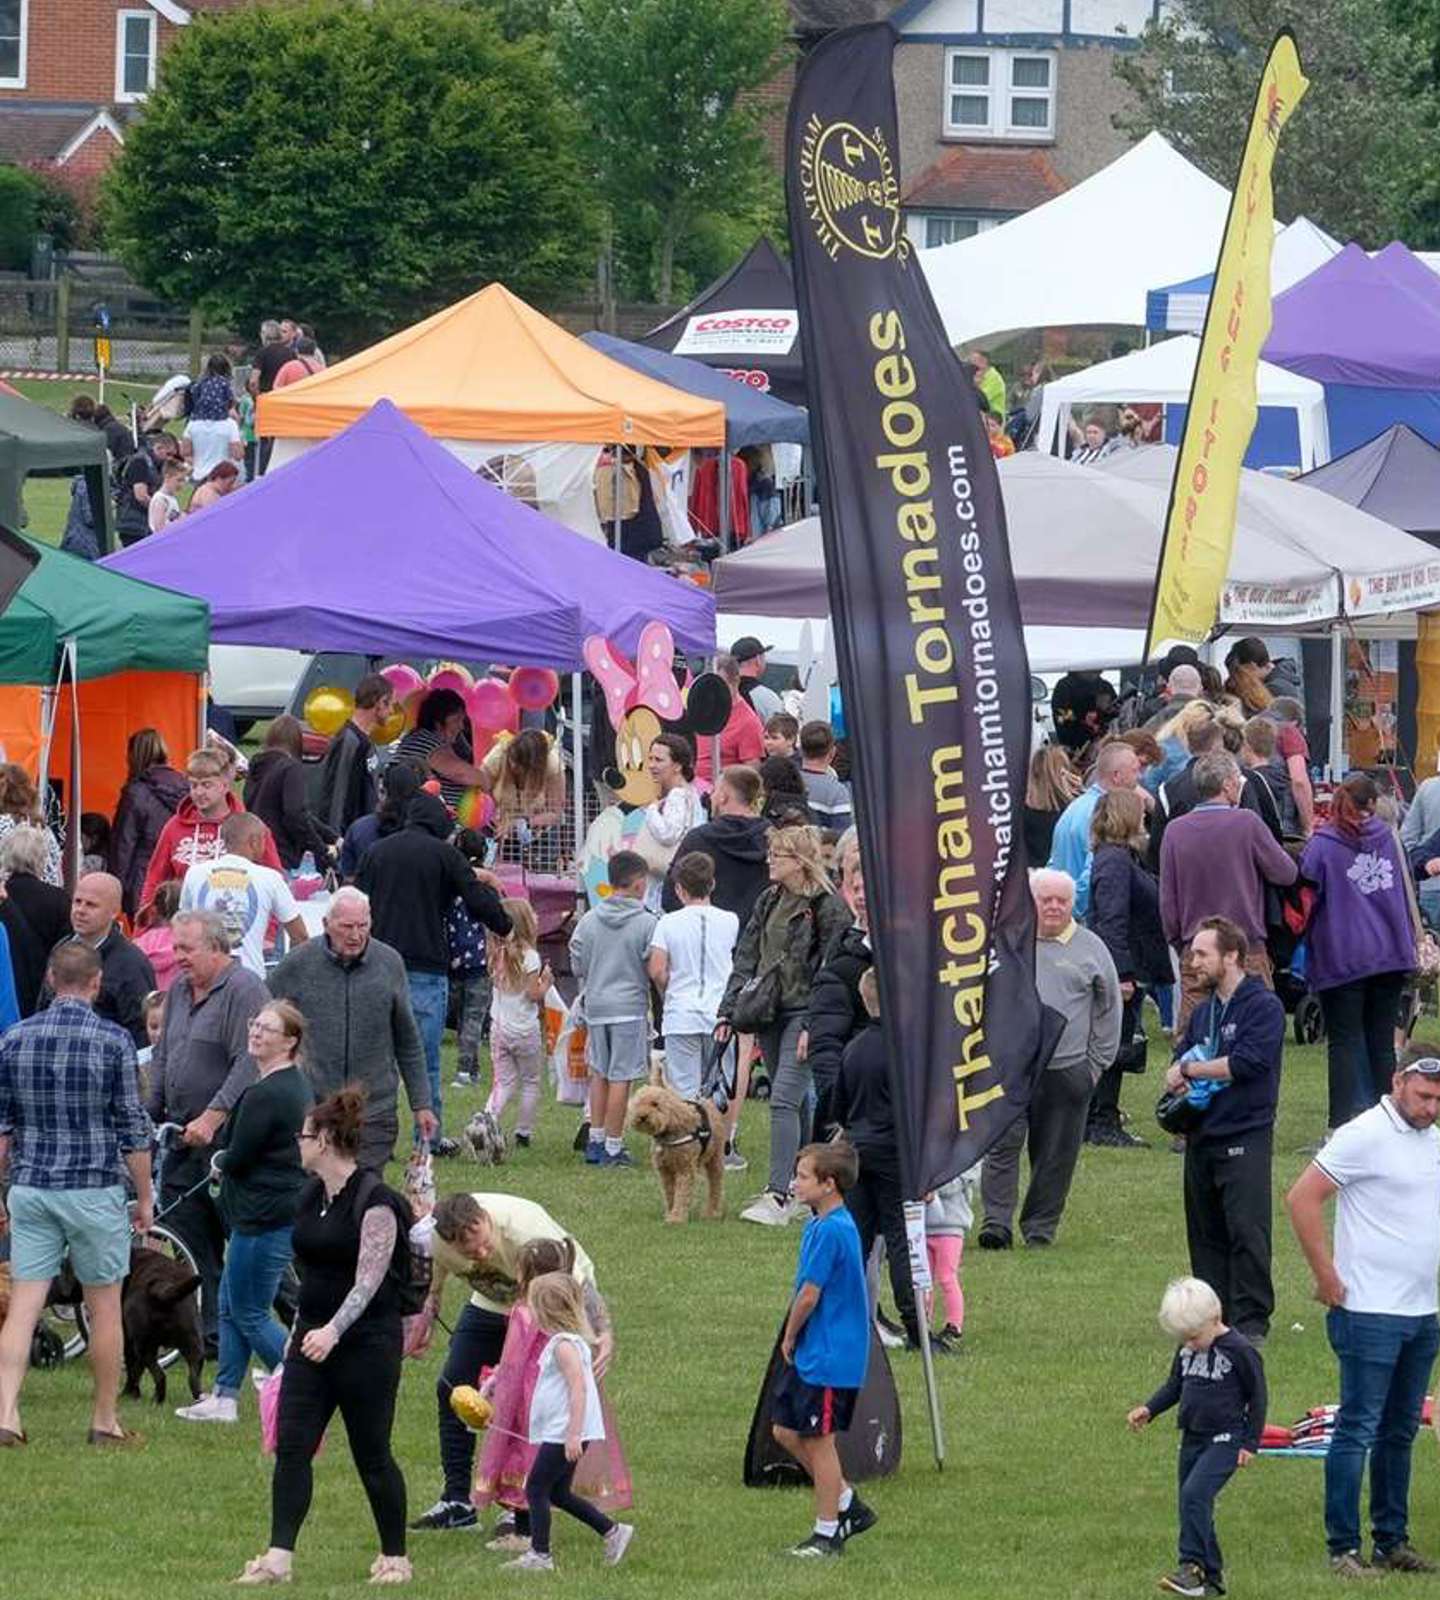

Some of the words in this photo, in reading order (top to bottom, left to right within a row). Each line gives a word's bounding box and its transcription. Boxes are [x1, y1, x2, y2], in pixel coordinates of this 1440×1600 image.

[695, 317, 791, 332] COSTCO
[800, 112, 840, 262] THATCHAM
[869, 308, 958, 724] Tornadoes
[947, 444, 1013, 975] w.thatchamtornadoes.com
[931, 743, 1006, 1132] Thatcham
